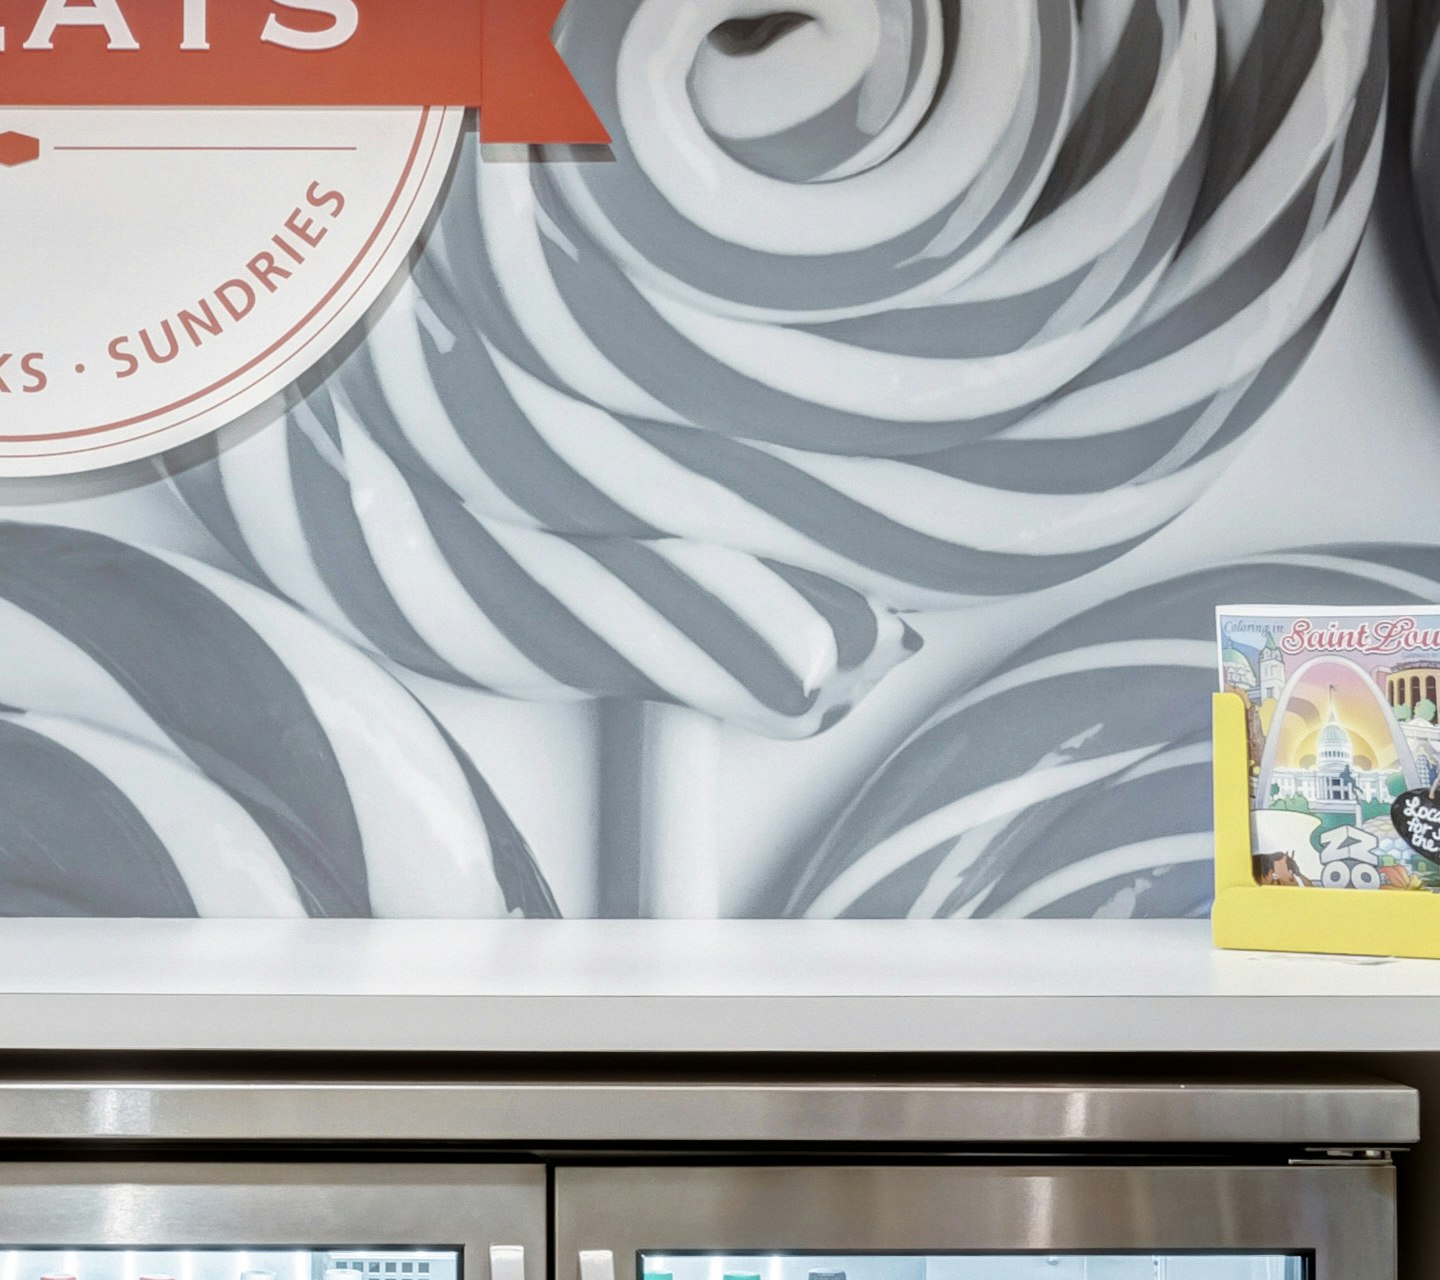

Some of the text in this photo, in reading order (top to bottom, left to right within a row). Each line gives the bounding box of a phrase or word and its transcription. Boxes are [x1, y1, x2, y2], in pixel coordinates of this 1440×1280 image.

[107, 181, 347, 380] SUNDRIES
[1223, 621, 1268, 637] Coloring
[1272, 622, 1284, 633] in
[1281, 618, 1369, 655] Saint
[1407, 818, 1433, 836] for
[1411, 833, 1439, 852] the
